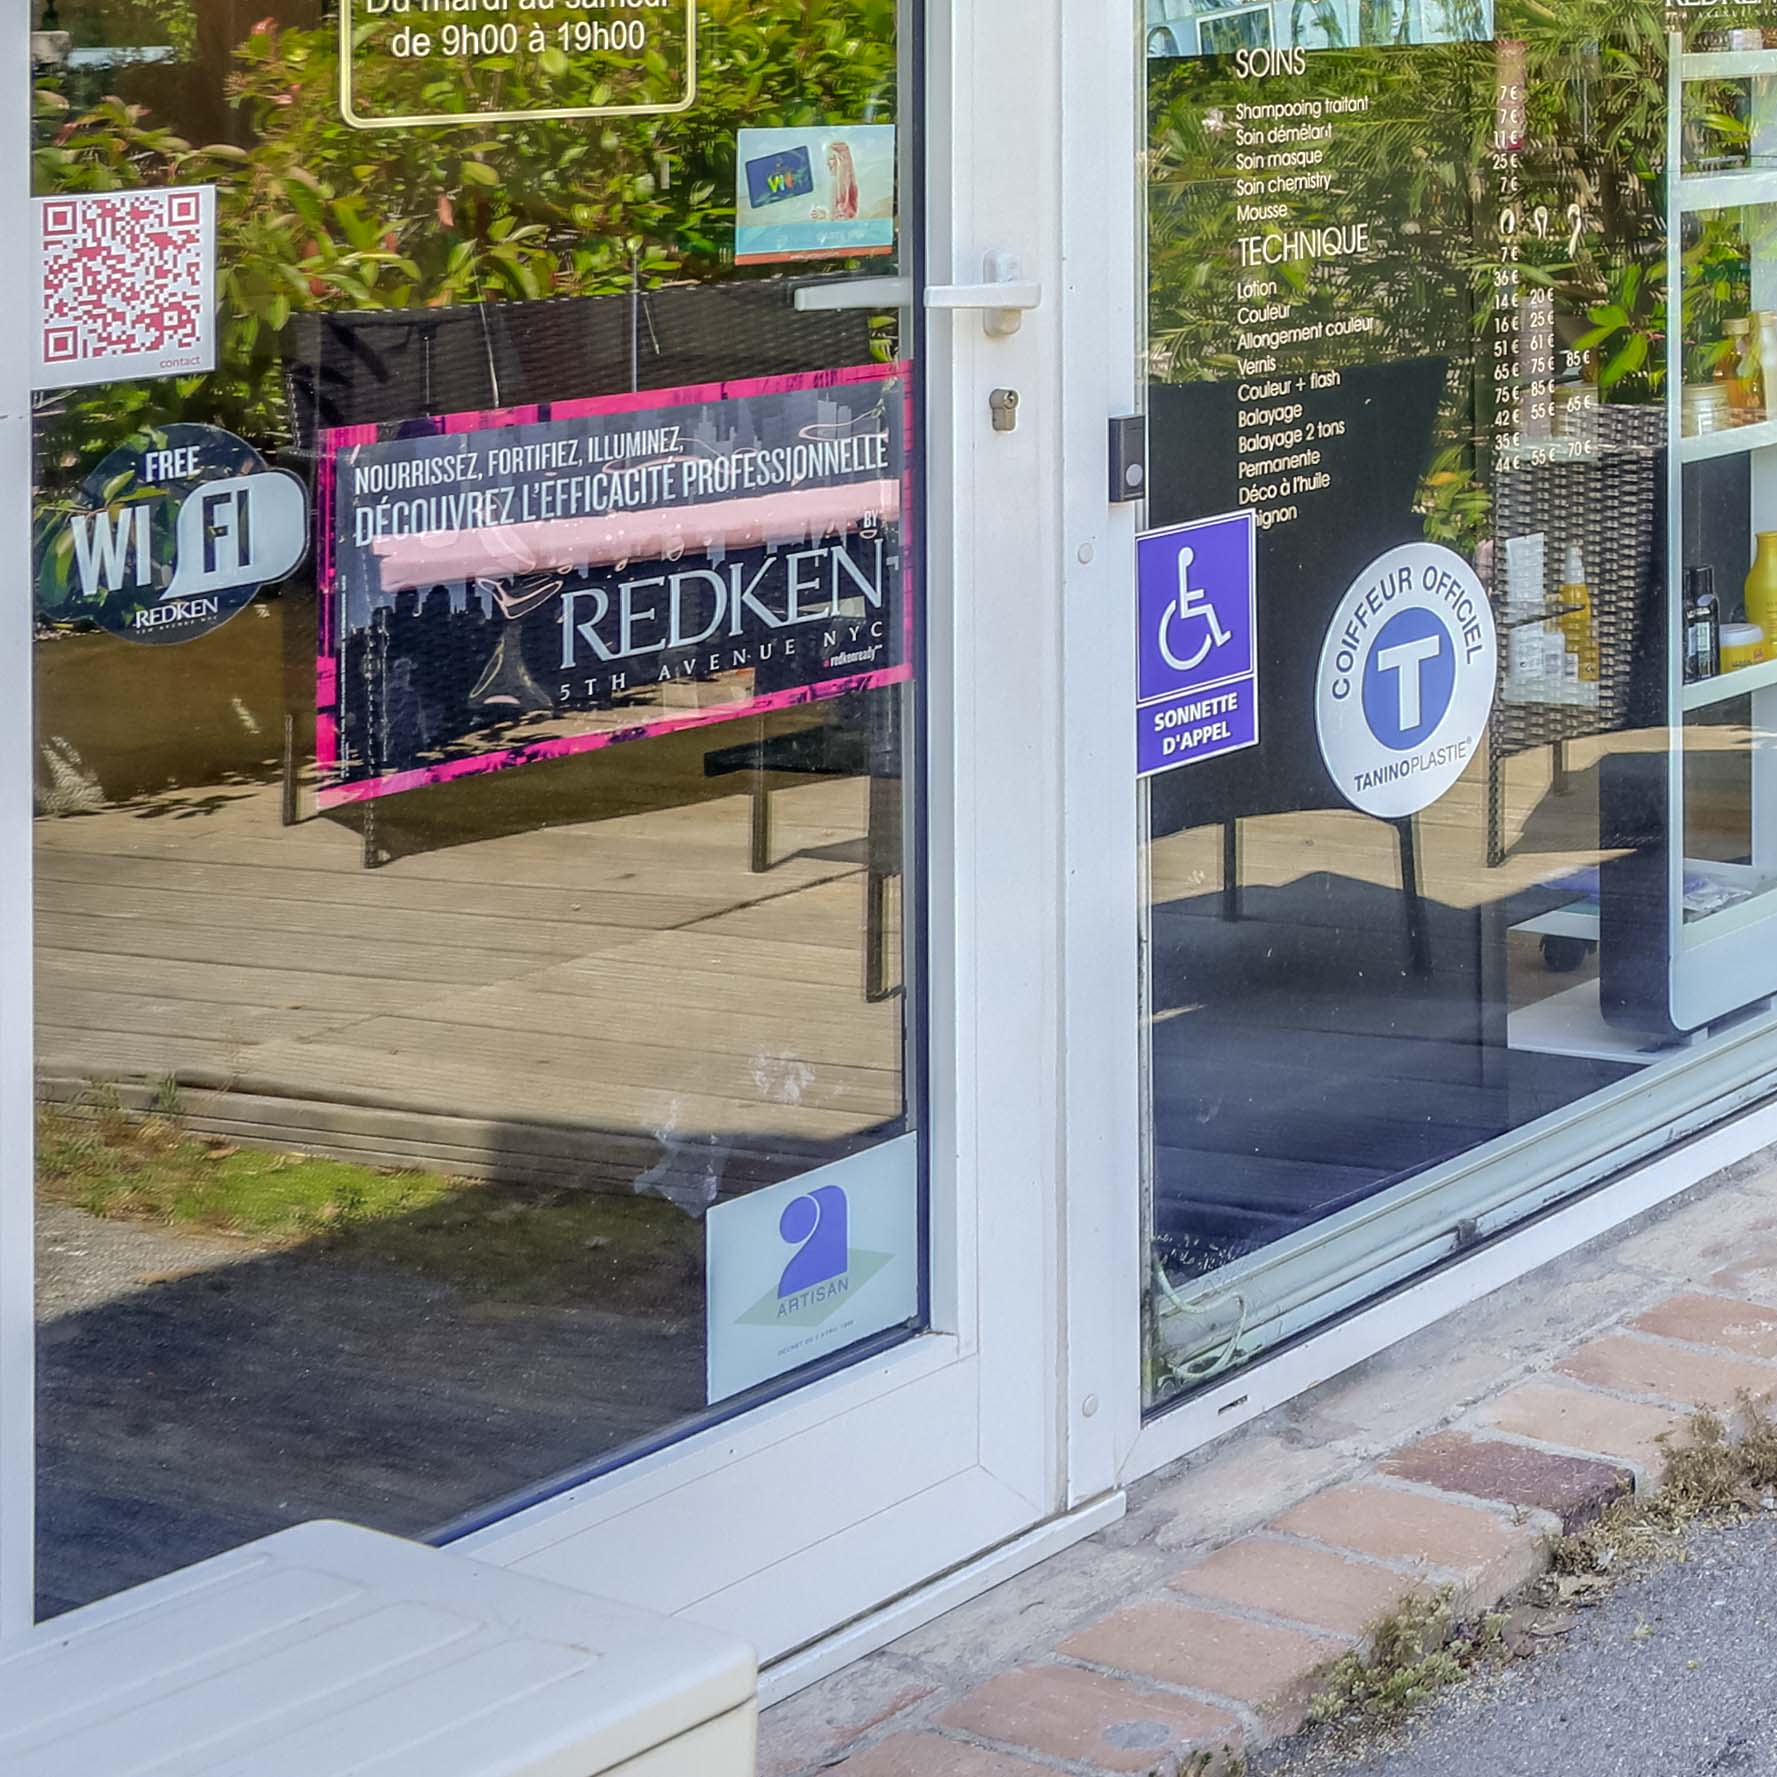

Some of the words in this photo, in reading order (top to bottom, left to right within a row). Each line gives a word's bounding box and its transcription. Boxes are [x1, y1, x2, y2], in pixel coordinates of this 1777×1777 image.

[390, 24, 433, 58] de
[441, 22, 518, 57] 9h00
[528, 21, 546, 52] à
[557, 19, 645, 52] 19h00
[1235, 46, 1306, 80] SOINS
[1236, 97, 1321, 122] Shampooing
[1324, 95, 1369, 117] traitant
[1236, 127, 1264, 146] Soin
[1267, 123, 1332, 144] démêlant
[1236, 152, 1264, 171] Soin
[1267, 149, 1322, 170] masque
[1493, 154, 1508, 170] 25
[1236, 178, 1265, 197] Soin
[1267, 173, 1332, 195] chemistry
[1237, 204, 1288, 222] Mousse
[1238, 224, 1369, 267] TECHNIQUE
[1237, 280, 1277, 301] Lotion
[1493, 271, 1508, 287] 36
[1238, 304, 1291, 326] Couleur
[1495, 295, 1508, 311] 14
[1237, 323, 1322, 351] Allongement
[1326, 318, 1374, 338] couleur
[1495, 317, 1509, 333] 16
[1238, 358, 1277, 377] Vernis
[1531, 358, 1545, 374] 75
[1566, 350, 1581, 366] 85
[1238, 382, 1291, 403] Couleur
[1295, 380, 1306, 392] +
[1310, 371, 1341, 389] flash
[1238, 403, 1303, 428] Balayage
[1238, 428, 1303, 454] Balayage
[1306, 424, 1315, 441] 2
[1317, 419, 1345, 438] tons
[145, 445, 201, 483] FREE
[354, 451, 484, 495] NOURRISSEZ,
[488, 437, 583, 478] FORTIFIEZ,
[587, 425, 684, 462] ILLUMINEZ,
[1239, 449, 1321, 479] Permanente
[355, 489, 515, 548] DÉCOUVREZ
[521, 455, 676, 524] L'EFFICACITÉ
[682, 434, 888, 497] PROFESSIONNELLE
[1239, 485, 1277, 505] Déco
[1280, 477, 1290, 496] à
[1292, 472, 1330, 493] l'huile
[863, 510, 878, 528] BY
[1252, 504, 1298, 529] hignon
[70, 504, 152, 597] WI
[202, 488, 252, 574] FI
[135, 596, 219, 628] REDKEN
[561, 540, 884, 670] REDKEN
[1332, 566, 1412, 701] COIFFEUR
[1422, 565, 1486, 666] OFFICIEL
[560, 673, 626, 702] 5TH
[658, 644, 796, 681] AVENUE
[823, 621, 884, 647] NYC
[1377, 634, 1440, 732] T
[1154, 692, 1238, 733] SONNETTE
[1162, 722, 1231, 756] D'APPEL
[777, 1278, 850, 1319] ARTISAN
